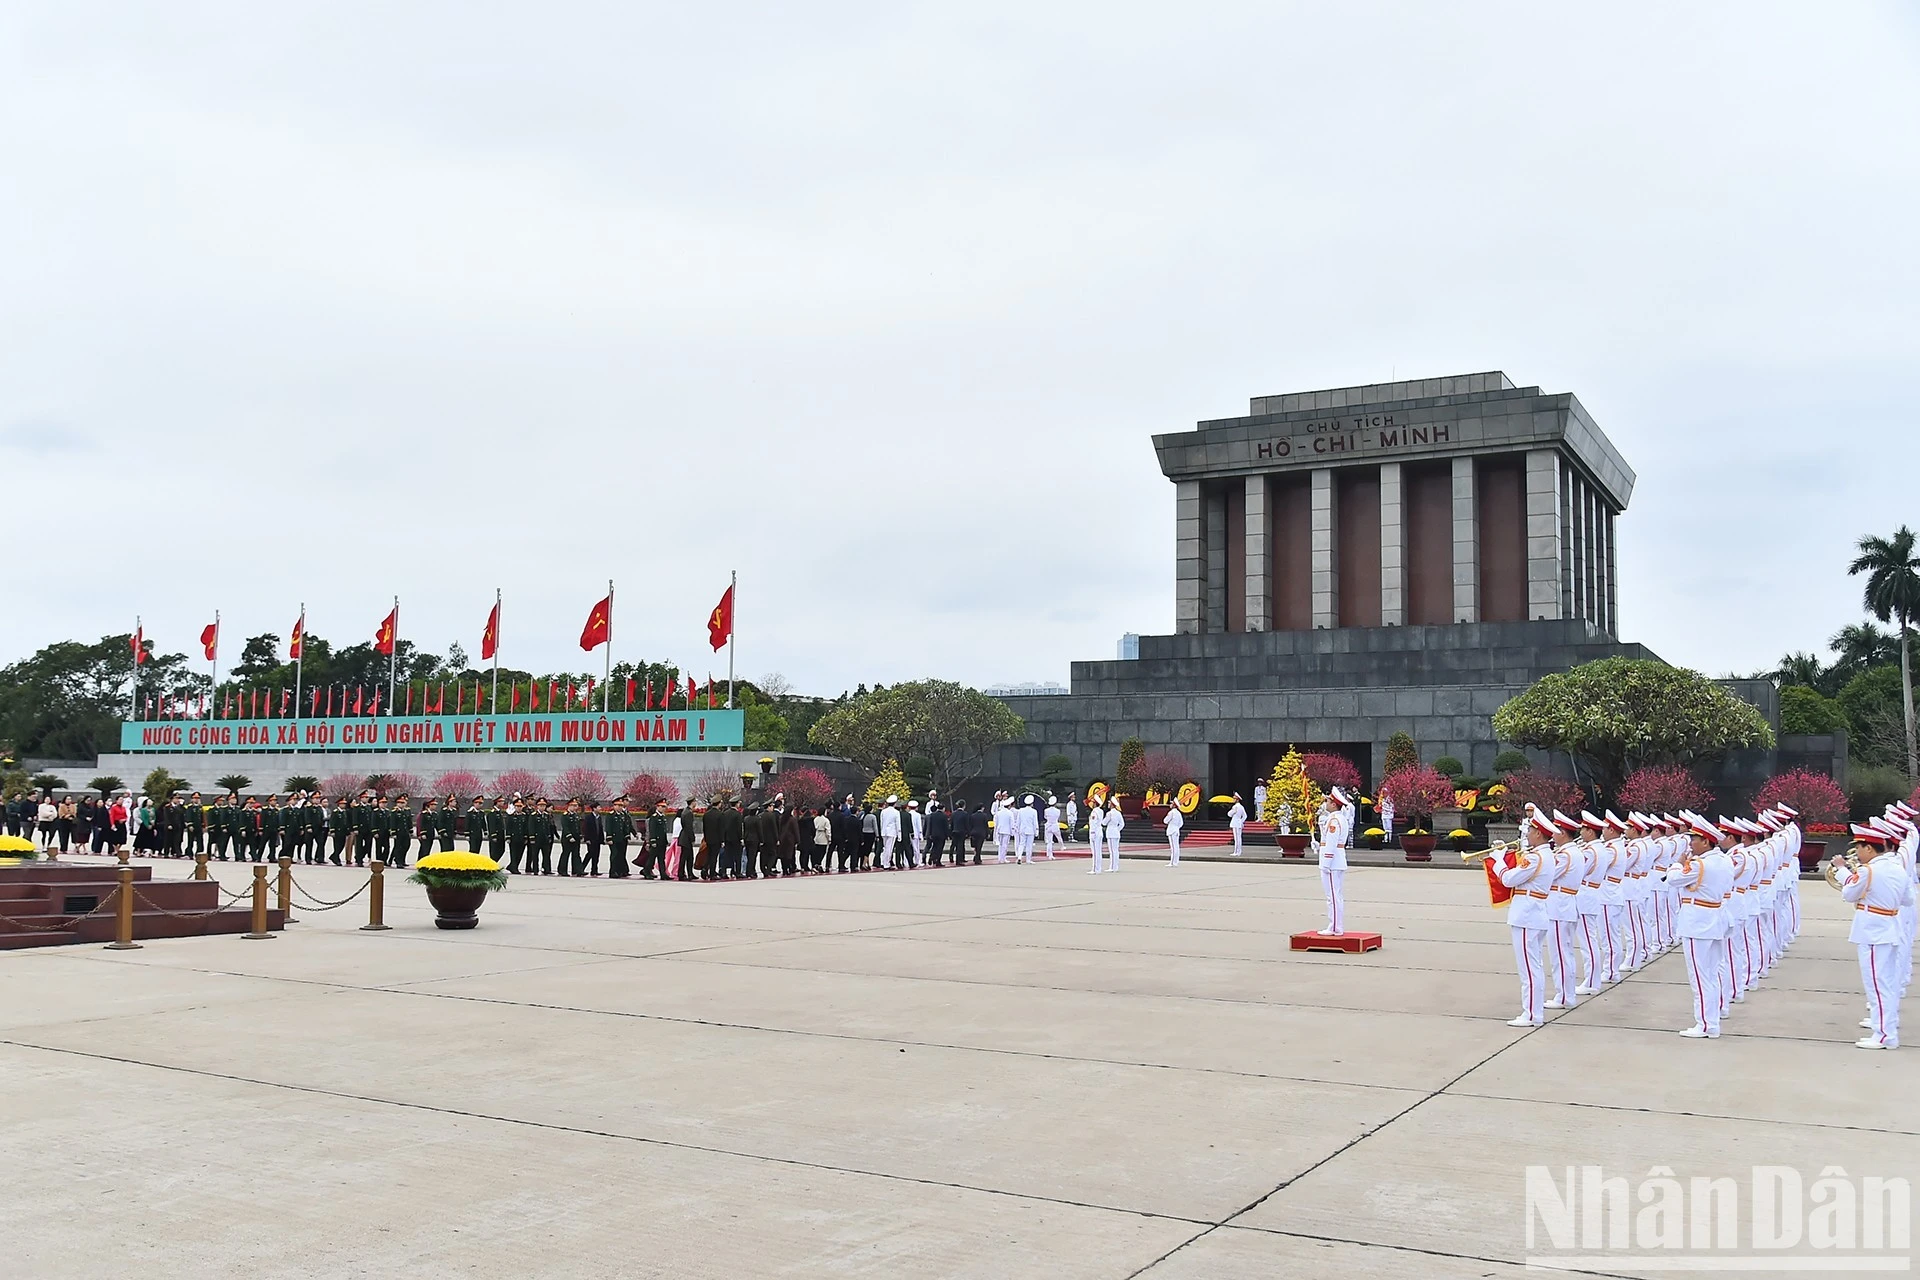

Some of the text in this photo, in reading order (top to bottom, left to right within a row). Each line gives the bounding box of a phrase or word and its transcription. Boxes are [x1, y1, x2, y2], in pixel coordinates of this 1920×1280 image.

[1380, 424, 1449, 448] MINH
[143, 724, 182, 746] NƯỚC
[189, 723, 231, 748] CỘNG
[238, 723, 269, 745] HÒA
[276, 722, 298, 744] XÃ
[306, 721, 335, 748] HỘI
[342, 718, 378, 744] CHỦ
[386, 719, 443, 744] NGHĨA
[453, 718, 496, 747] VIỆT
[505, 721, 552, 743] NAM
[561, 716, 626, 742] MUÔN
[635, 714, 687, 742] NĂM
